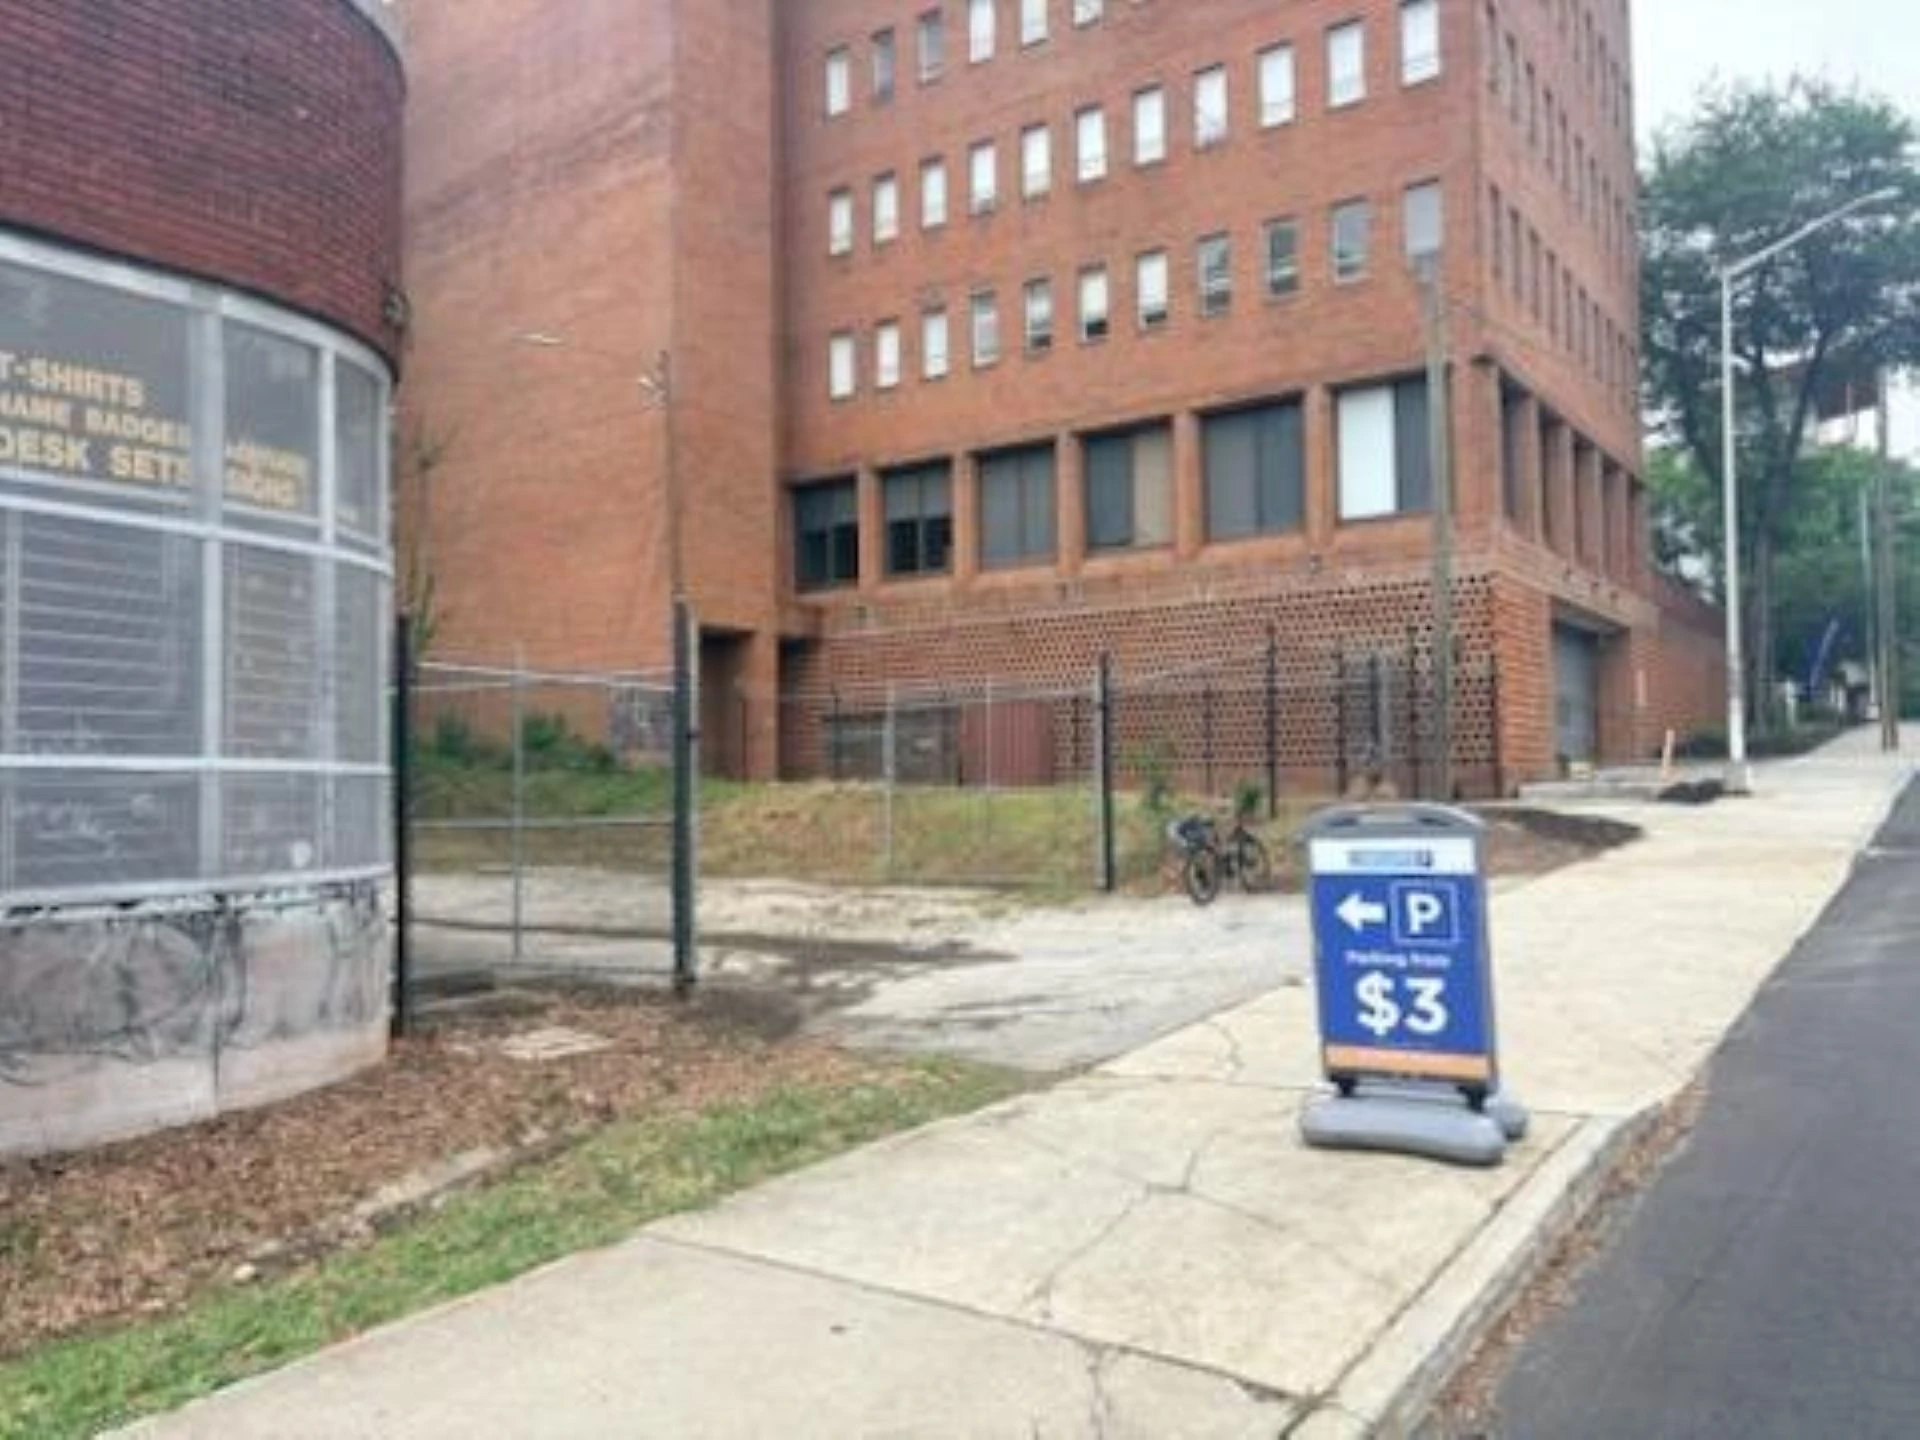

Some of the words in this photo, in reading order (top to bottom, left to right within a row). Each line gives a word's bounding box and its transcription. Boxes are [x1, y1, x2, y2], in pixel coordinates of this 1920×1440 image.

[0, 351, 143, 408] T-SHIRTS
[0, 426, 92, 471] DESK
[1405, 892, 1442, 935] P
[1355, 971, 1447, 1035] $3
